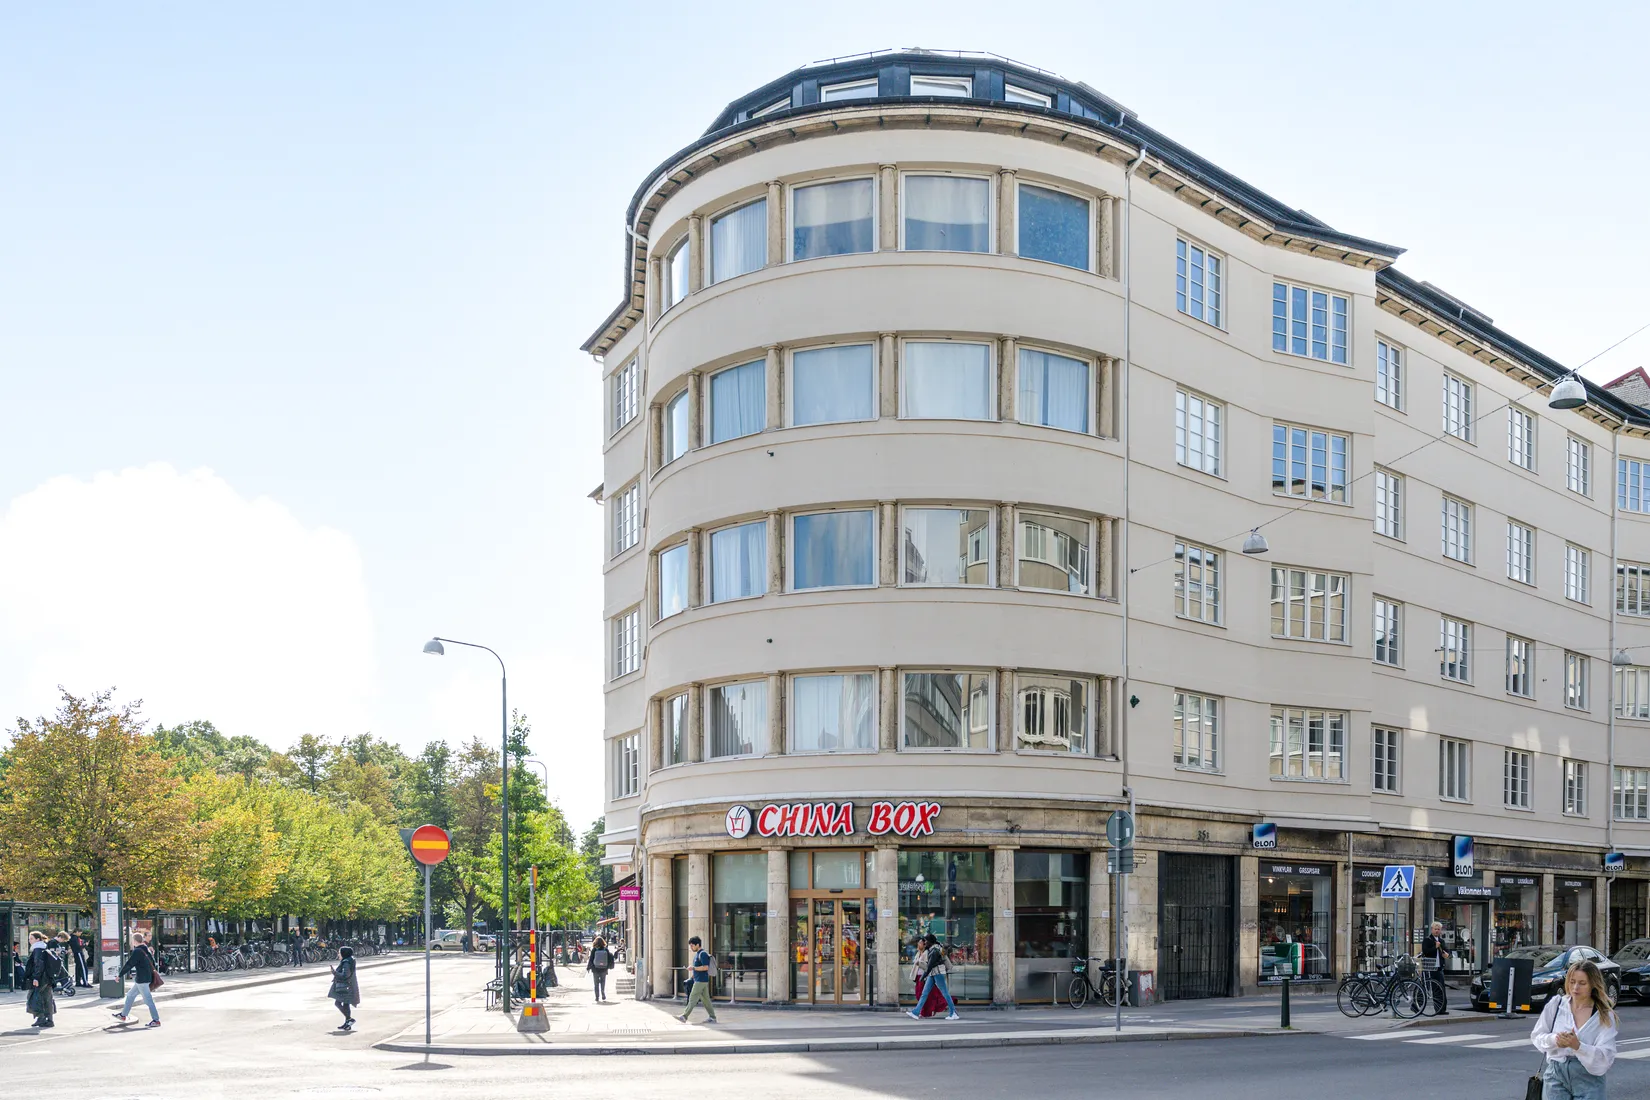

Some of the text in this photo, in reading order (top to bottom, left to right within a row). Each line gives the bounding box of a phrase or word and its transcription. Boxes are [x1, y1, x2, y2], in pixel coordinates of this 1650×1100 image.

[757, 801, 941, 838] CHINA BOX
[1272, 865, 1293, 873] VINKYLAR
[1455, 864, 1473, 876] elon
[1361, 870, 1382, 878] COOKSHOP
[106, 893, 112, 902] E
